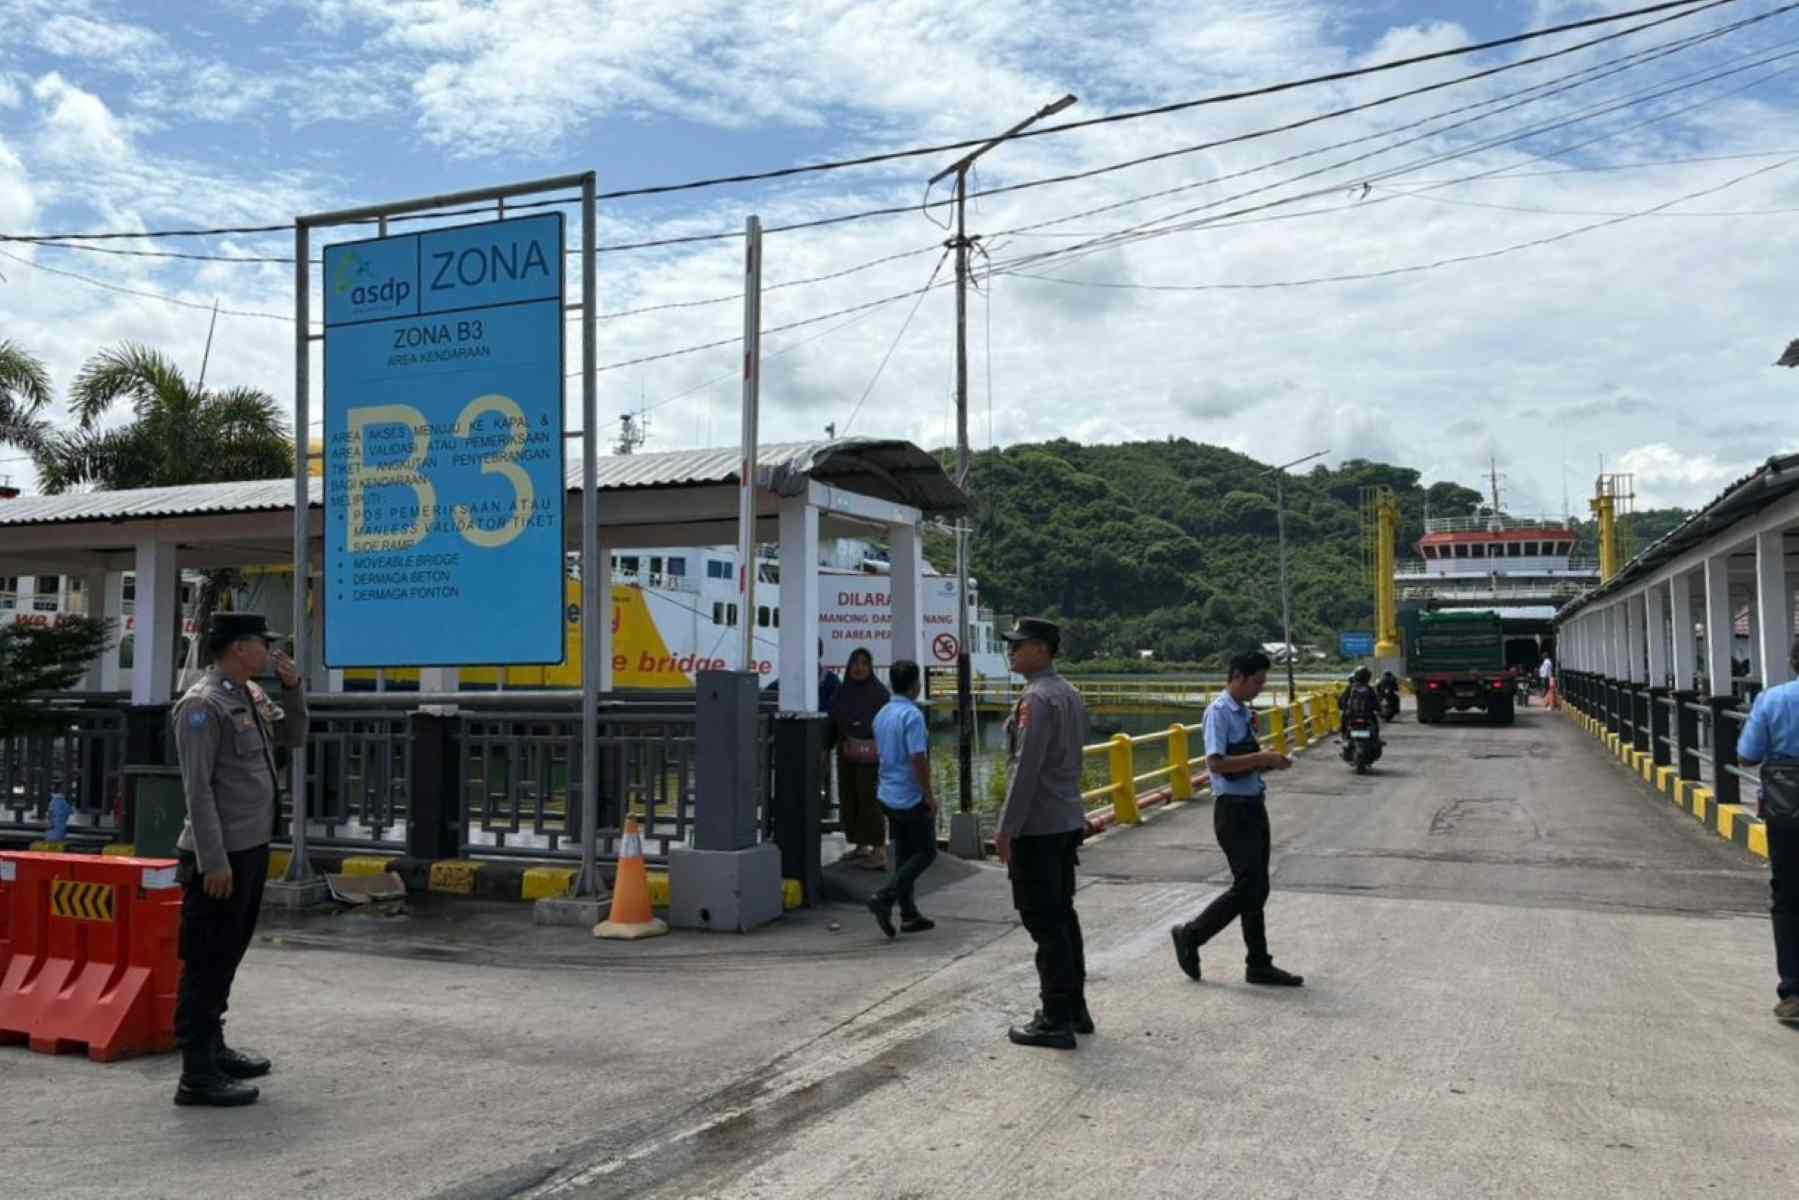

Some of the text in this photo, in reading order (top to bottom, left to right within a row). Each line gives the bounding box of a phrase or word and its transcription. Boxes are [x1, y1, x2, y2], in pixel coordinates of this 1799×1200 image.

[431, 239, 549, 291] ZONA
[351, 277, 410, 306] asdp
[393, 320, 483, 348] ZONA B3
[388, 353, 417, 366] AREA
[332, 431, 361, 443] AREA
[369, 427, 405, 440] AKSES
[469, 420, 485, 431] KE
[332, 447, 361, 458] AREA
[427, 438, 457, 451] ATAU
[347, 394, 533, 552] B3
[353, 507, 383, 521] POS
[508, 495, 551, 511] ATAU
[353, 523, 417, 537] MANLESS
[511, 514, 555, 529] TIKET
[818, 614, 869, 625] MANCING
[846, 630, 872, 640] AREA
[638, 651, 726, 673] bridge
